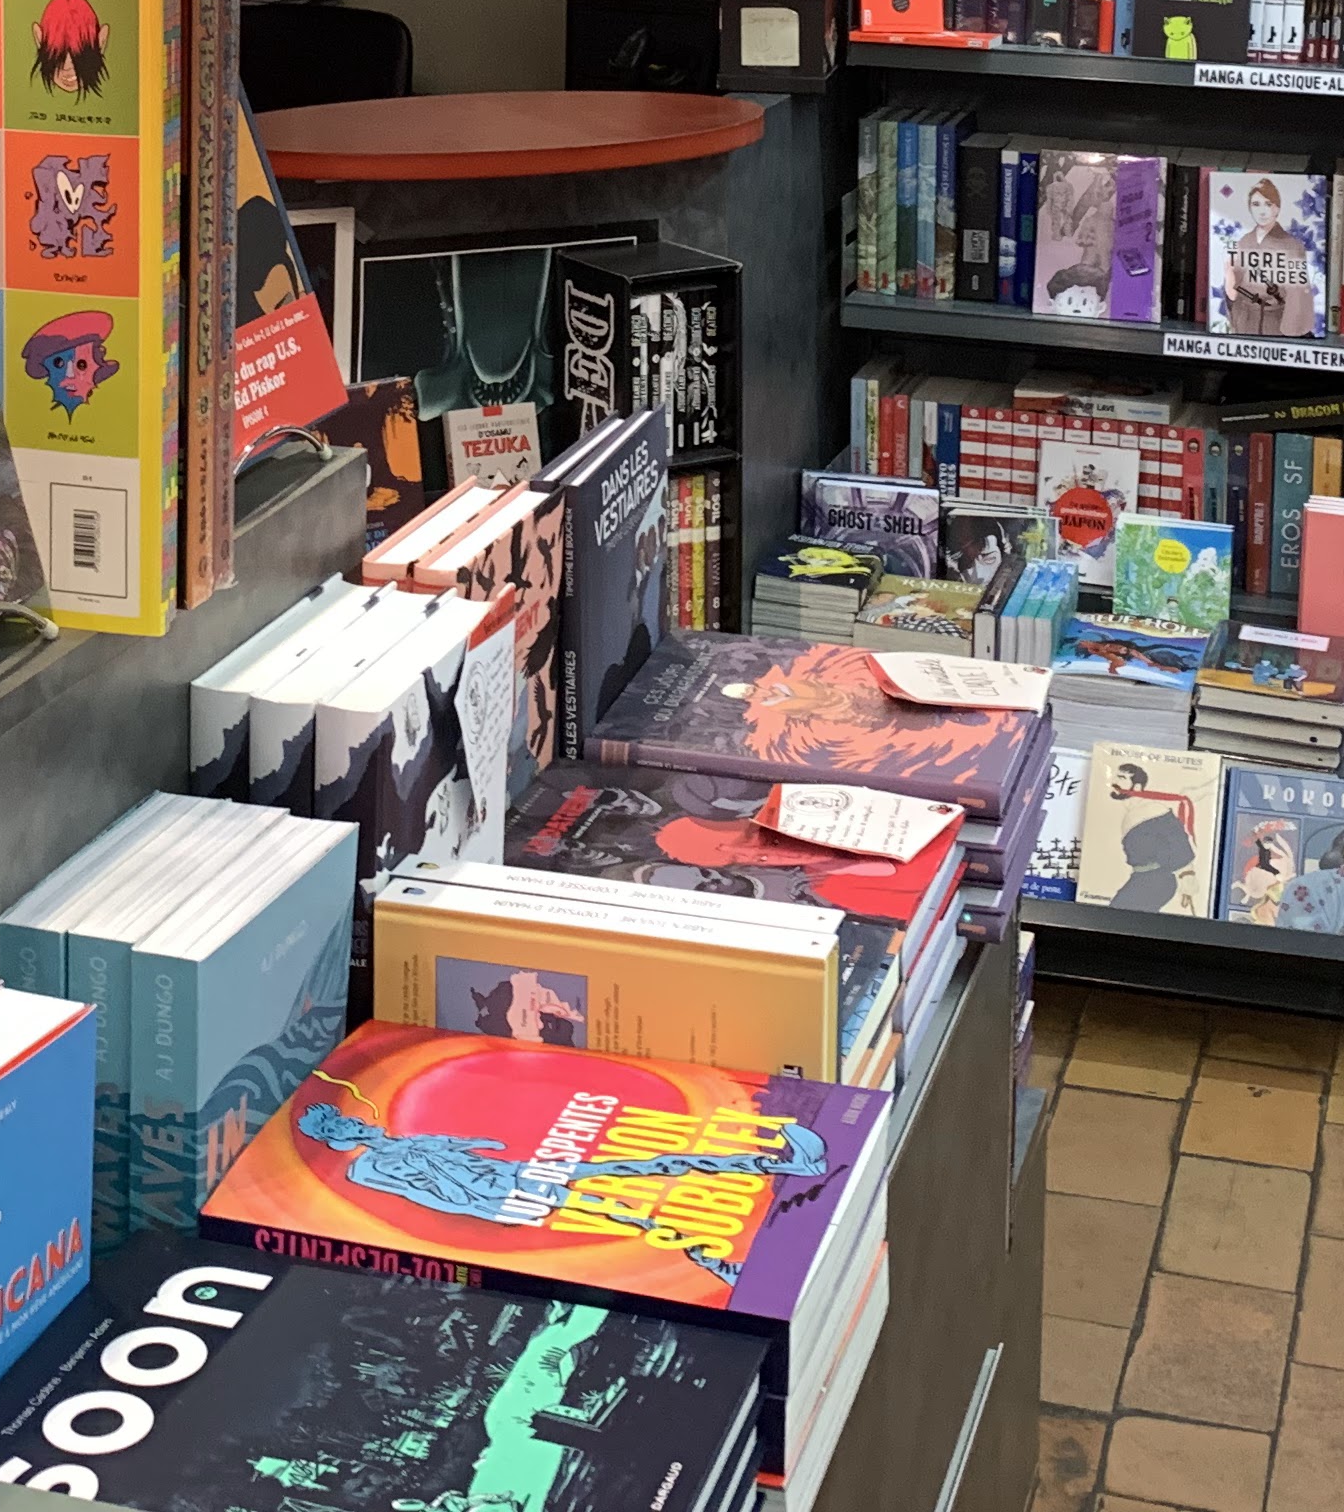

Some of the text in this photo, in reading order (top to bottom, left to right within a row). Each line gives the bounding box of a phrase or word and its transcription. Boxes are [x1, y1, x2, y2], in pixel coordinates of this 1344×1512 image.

[1199, 69, 1243, 85] MANGA
[1228, 251, 1308, 271] TIGRE DES
[1249, 270, 1308, 286] NEIGES
[256, 337, 302, 372] rap U.S.
[1167, 338, 1211, 356] MANGA
[234, 370, 286, 411] Ed Piskor
[1291, 402, 1340, 419] DRAGON
[461, 434, 532, 459] TEZUKA
[600, 439, 650, 509] DANS LES
[594, 458, 659, 547] VESTIAIRES
[1281, 459, 1303, 569] EROS SF
[828, 509, 926, 536] GHOST SHELL
[1061, 516, 1107, 531] JAPON
[565, 650, 577, 746] LES VESTIAIRES
[1111, 748, 1204, 766] HOUSE OF BRUTES
[154, 973, 175, 1083] AJ DUNGO
[495, 1090, 620, 1228] LUZ-DESPENTES
[649, 1459, 684, 1511] DARGAUD
